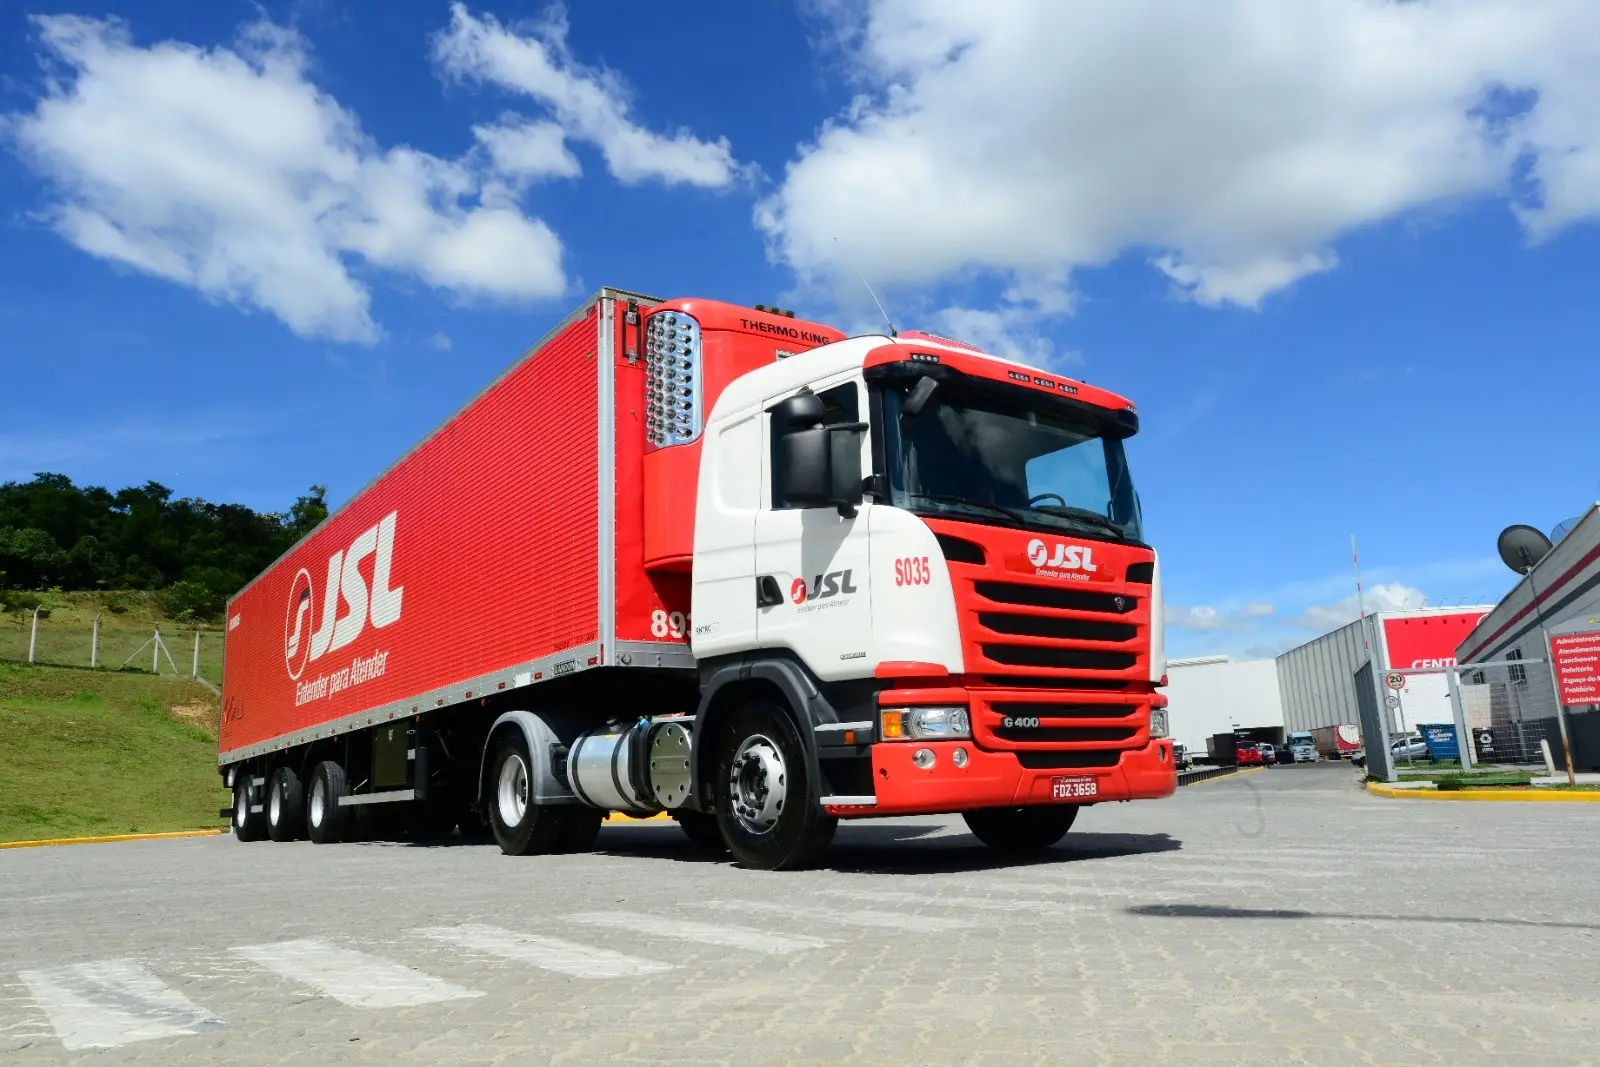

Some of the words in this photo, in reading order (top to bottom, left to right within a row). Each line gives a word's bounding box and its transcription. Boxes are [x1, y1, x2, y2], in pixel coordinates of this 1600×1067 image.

[740, 318, 798, 338] THERMO
[801, 330, 830, 344] KING
[1047, 543, 1097, 572] JSL
[895, 556, 931, 587] S035
[1036, 568, 1058, 578] Entender
[1059, 571, 1070, 579] para
[1071, 572, 1090, 581] Atender
[309, 510, 404, 662] JSL
[807, 569, 857, 600] JSL
[1558, 646, 1600, 655] Atendimento
[1560, 656, 1598, 664] Lanchonete
[1562, 666, 1594, 674] Refeitório
[295, 673, 330, 707] Entender
[328, 668, 350, 700] para
[349, 648, 389, 687] Atender
[1389, 675, 1402, 683] 20
[1563, 677, 1586, 685] Espaço
[1565, 685, 1595, 693] Fraldário
[1004, 717, 1013, 728] G
[1014, 717, 1039, 728] 400
